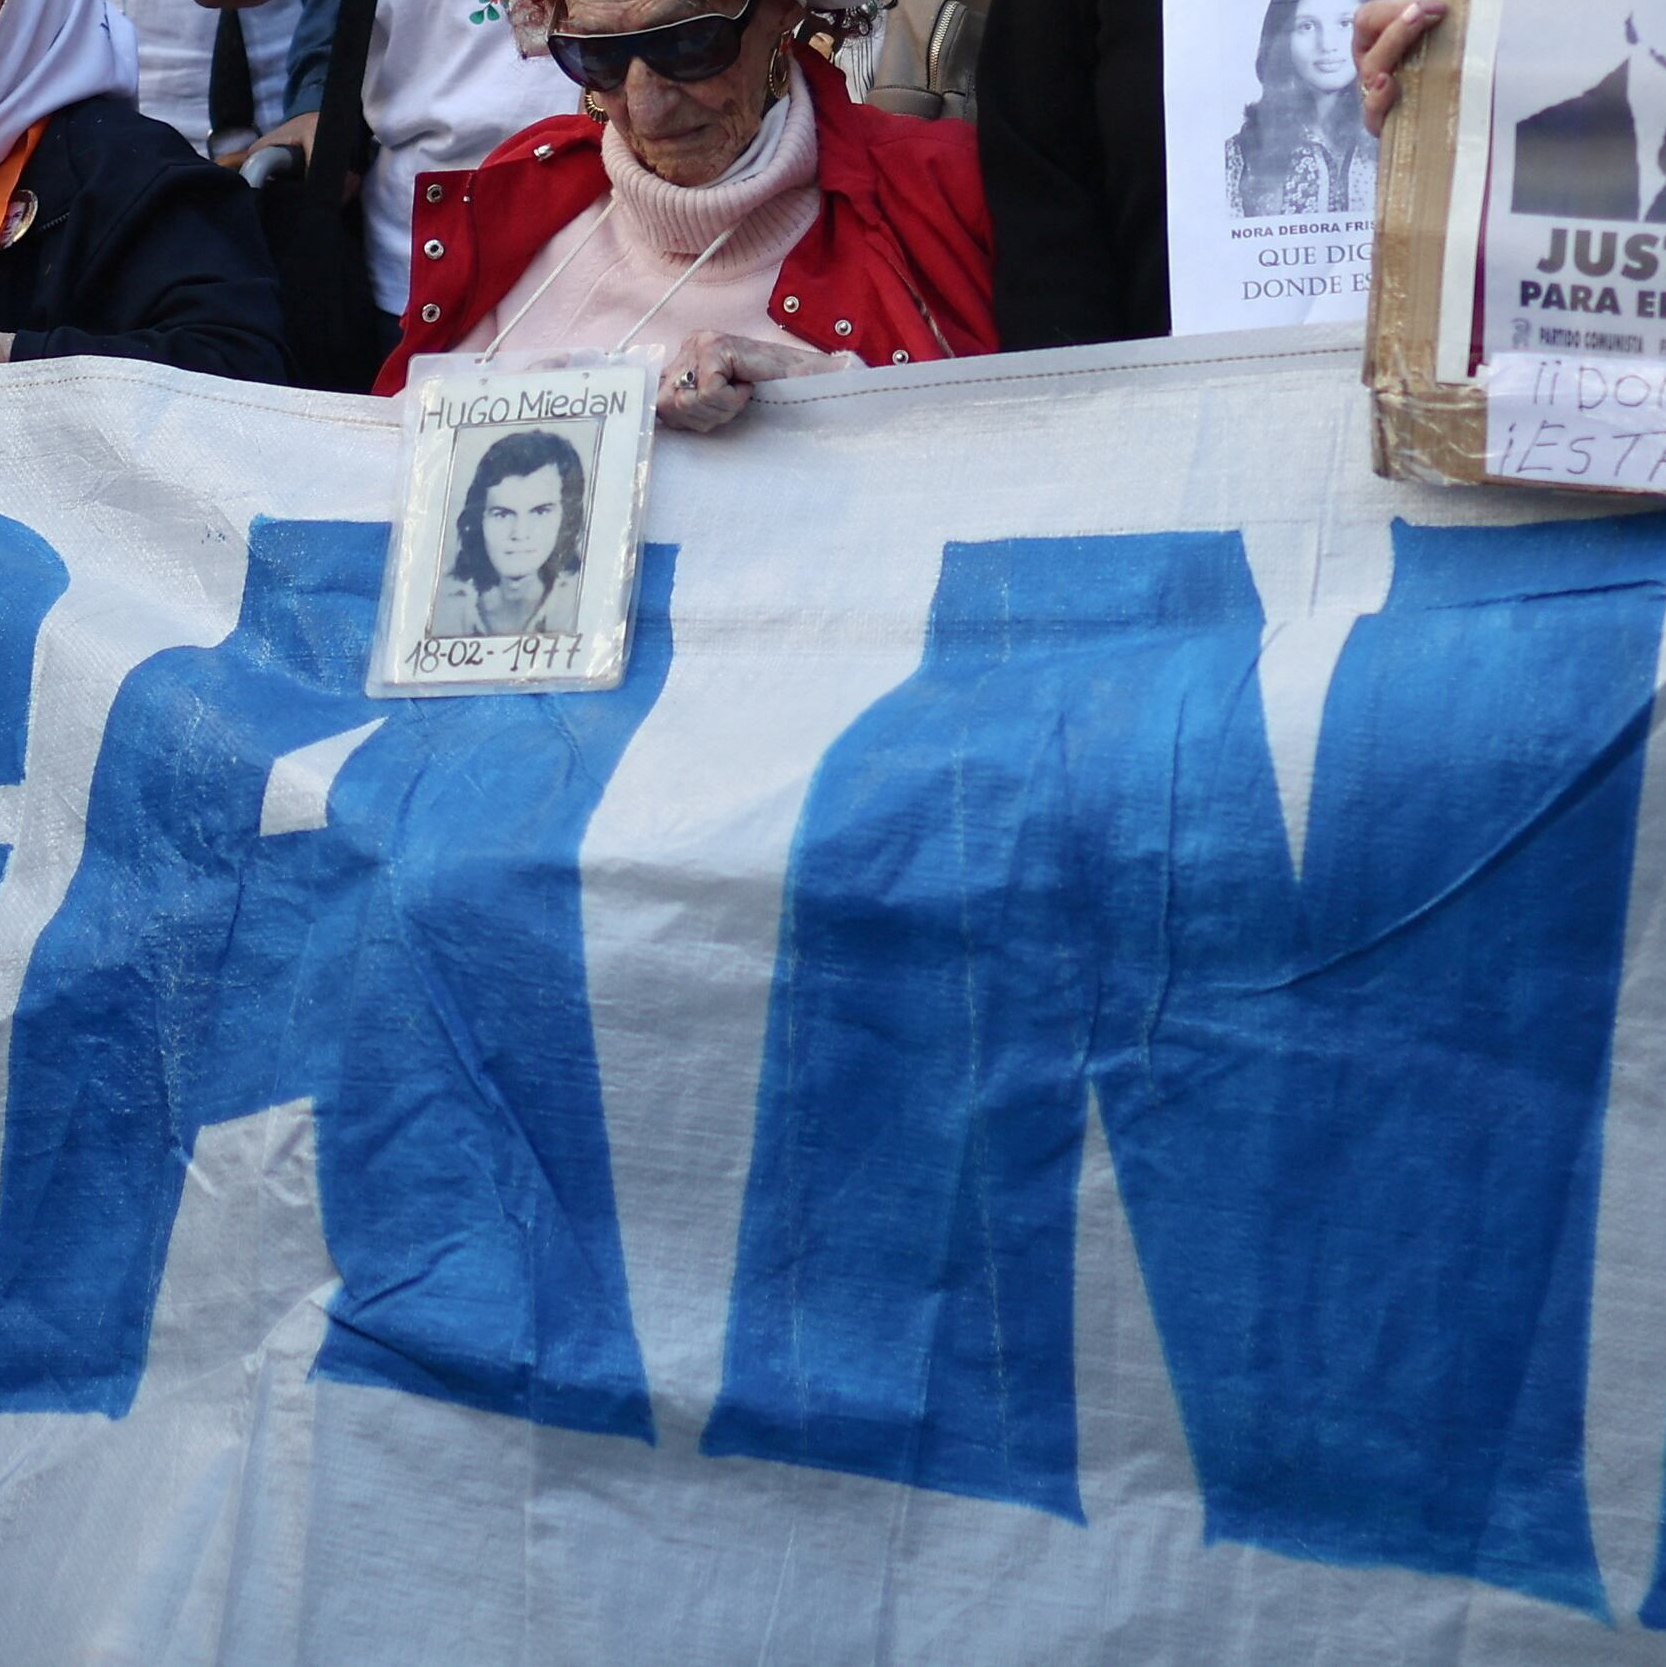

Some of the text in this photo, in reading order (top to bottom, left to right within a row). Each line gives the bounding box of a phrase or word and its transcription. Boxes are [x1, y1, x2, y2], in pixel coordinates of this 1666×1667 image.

[1231, 228, 1274, 240] NORA
[1278, 223, 1341, 237] DEBORA
[1258, 242, 1373, 268] QUE DIG
[1241, 277, 1342, 301] DONDE
[1519, 280, 1622, 317] PARA
[1539, 326, 1644, 355] PARTIDO COMUNISTA
[420, 395, 511, 434] HUGO
